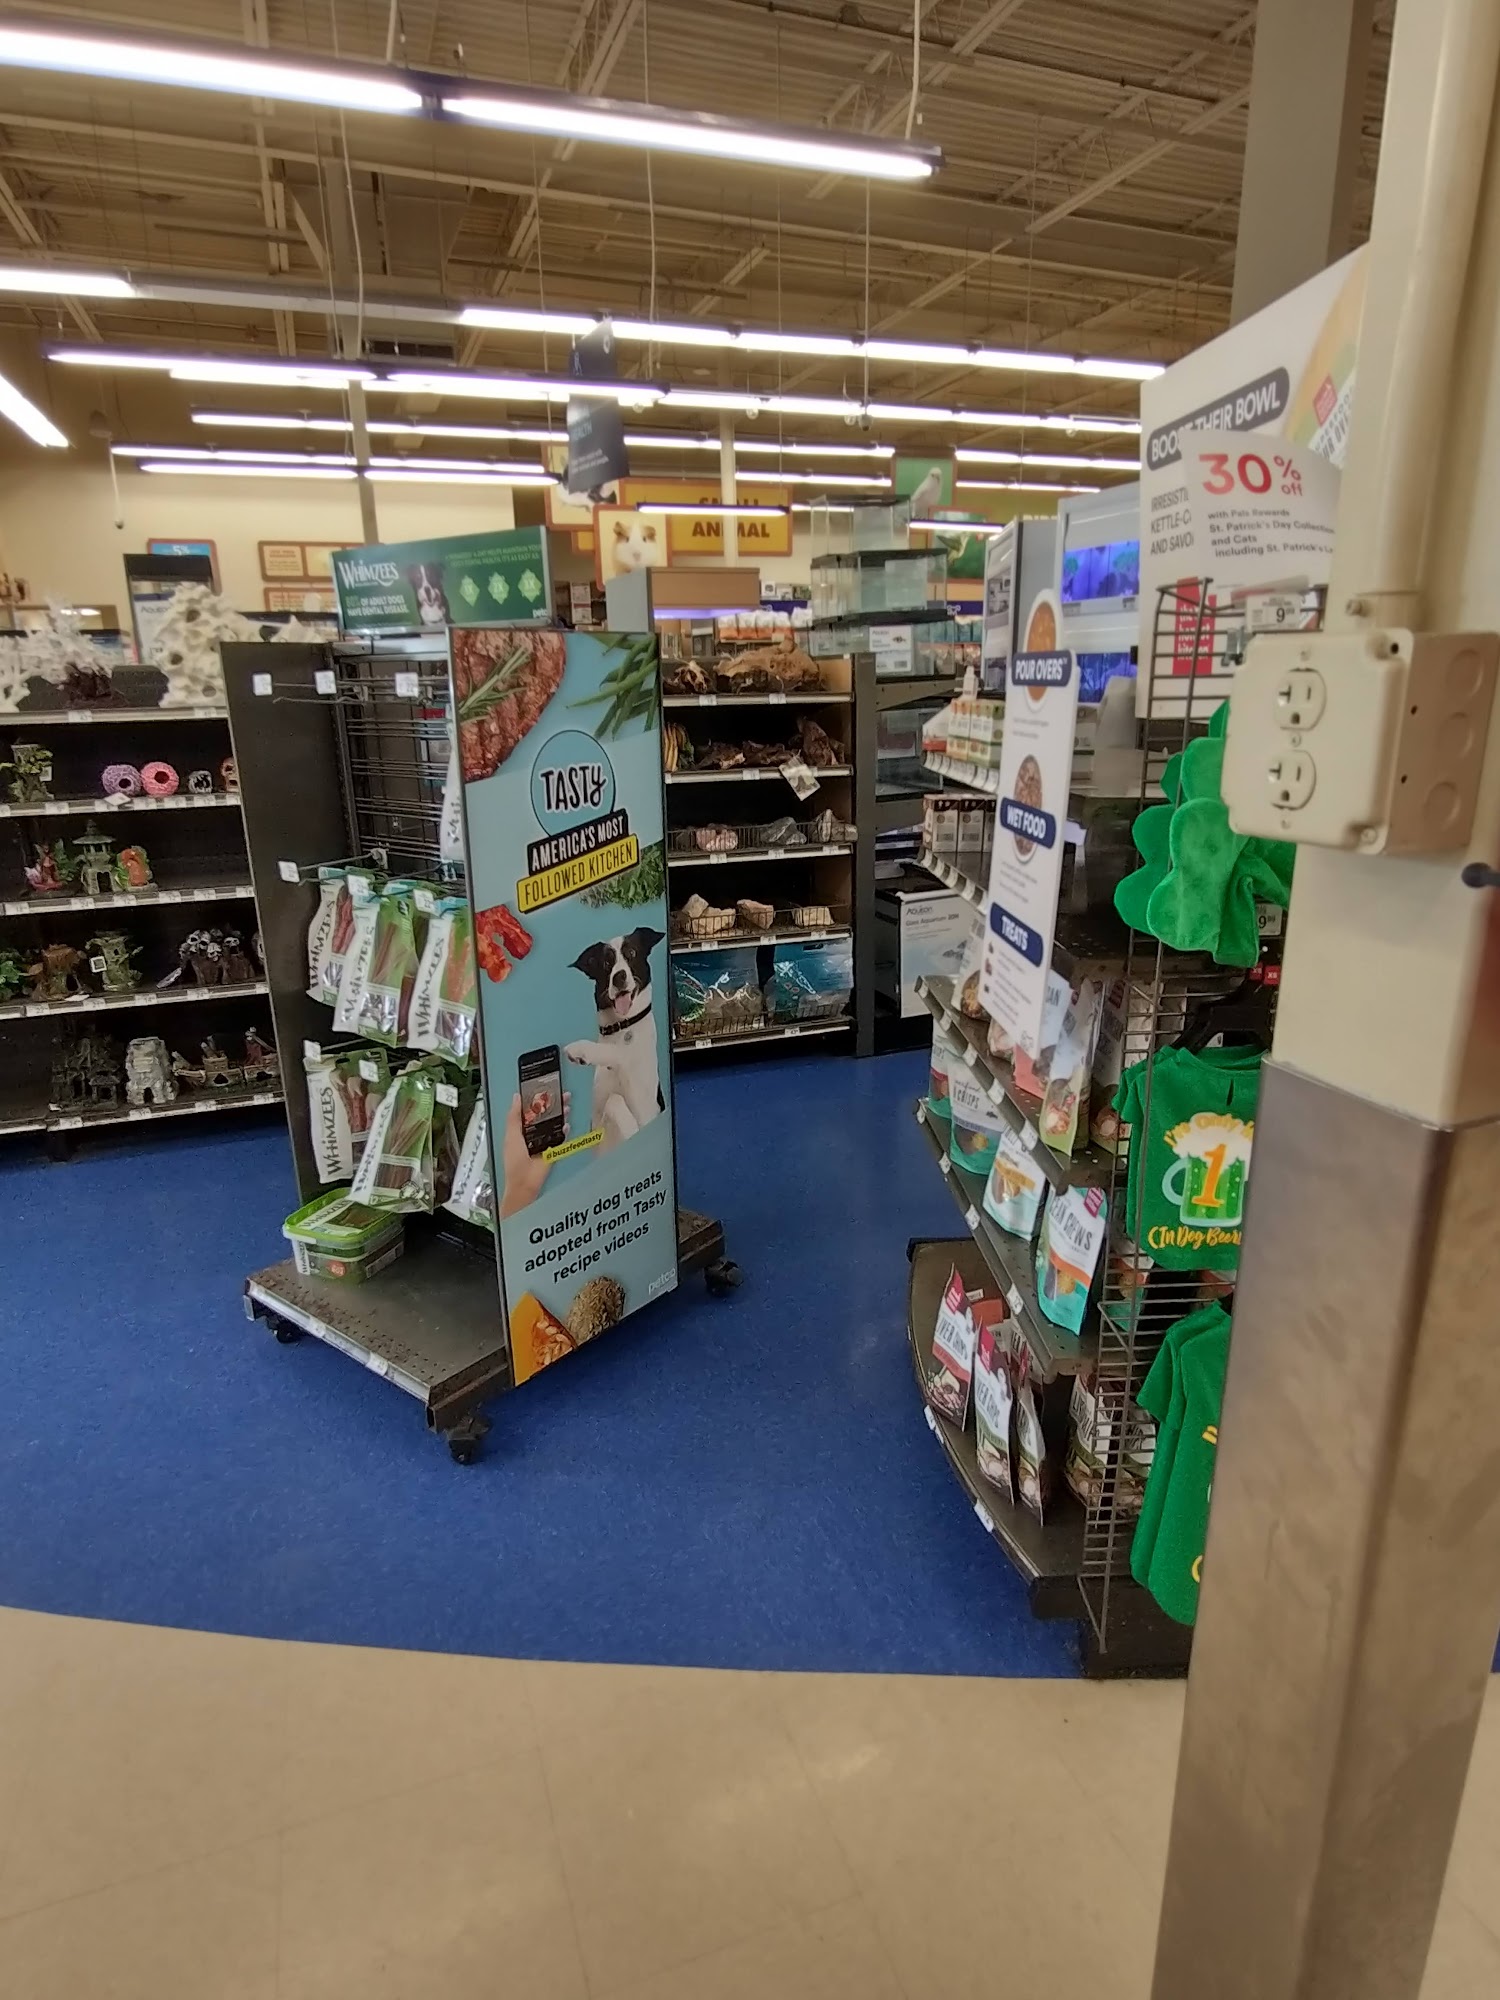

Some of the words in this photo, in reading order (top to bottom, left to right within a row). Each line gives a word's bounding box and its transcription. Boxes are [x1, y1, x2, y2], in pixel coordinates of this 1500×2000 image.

[1152, 421, 1193, 462] BOO
[1235, 381, 1280, 426] BOWL
[1281, 482, 1303, 497] off
[692, 521, 770, 538] ANAL
[1151, 508, 1192, 535] KETTLE-C
[1208, 510, 1229, 520] with
[1209, 523, 1224, 534] St.
[1226, 521, 1271, 532] Patrick's
[1272, 520, 1292, 531] Day
[1150, 538, 1168, 557] AND
[1169, 531, 1195, 553] SAVO
[1211, 536, 1231, 546] and
[1233, 535, 1258, 545] Cats
[1215, 544, 1264, 558] including
[1266, 543, 1281, 554] St.
[338, 559, 399, 589] WHIMZEES
[1015, 659, 1036, 680] POUR
[1006, 804, 1023, 830] WET
[1023, 810, 1047, 840] FOOD
[532, 825, 596, 872] AMERICA'S
[598, 815, 624, 844] MOST
[524, 861, 586, 906] FOLLOWED
[588, 840, 633, 879] KITCHEN
[1001, 914, 1029, 952] TREATS
[321, 1086, 343, 1177] WHIMZEES
[1194, 1113, 1240, 1133] Only
[1192, 1143, 1228, 1208] 1
[529, 1208, 589, 1245] Quality
[593, 1193, 621, 1216] dog
[624, 1170, 662, 1200] treats
[524, 1227, 593, 1273] adopted
[595, 1211, 630, 1238] from
[633, 1189, 667, 1217] Tasty
[1063, 1212, 1093, 1251] CHEWS
[1176, 1226, 1206, 1250] Dog
[553, 1250, 601, 1285] recipe
[604, 1222, 650, 1255] videos
[648, 1267, 676, 1296] petco
